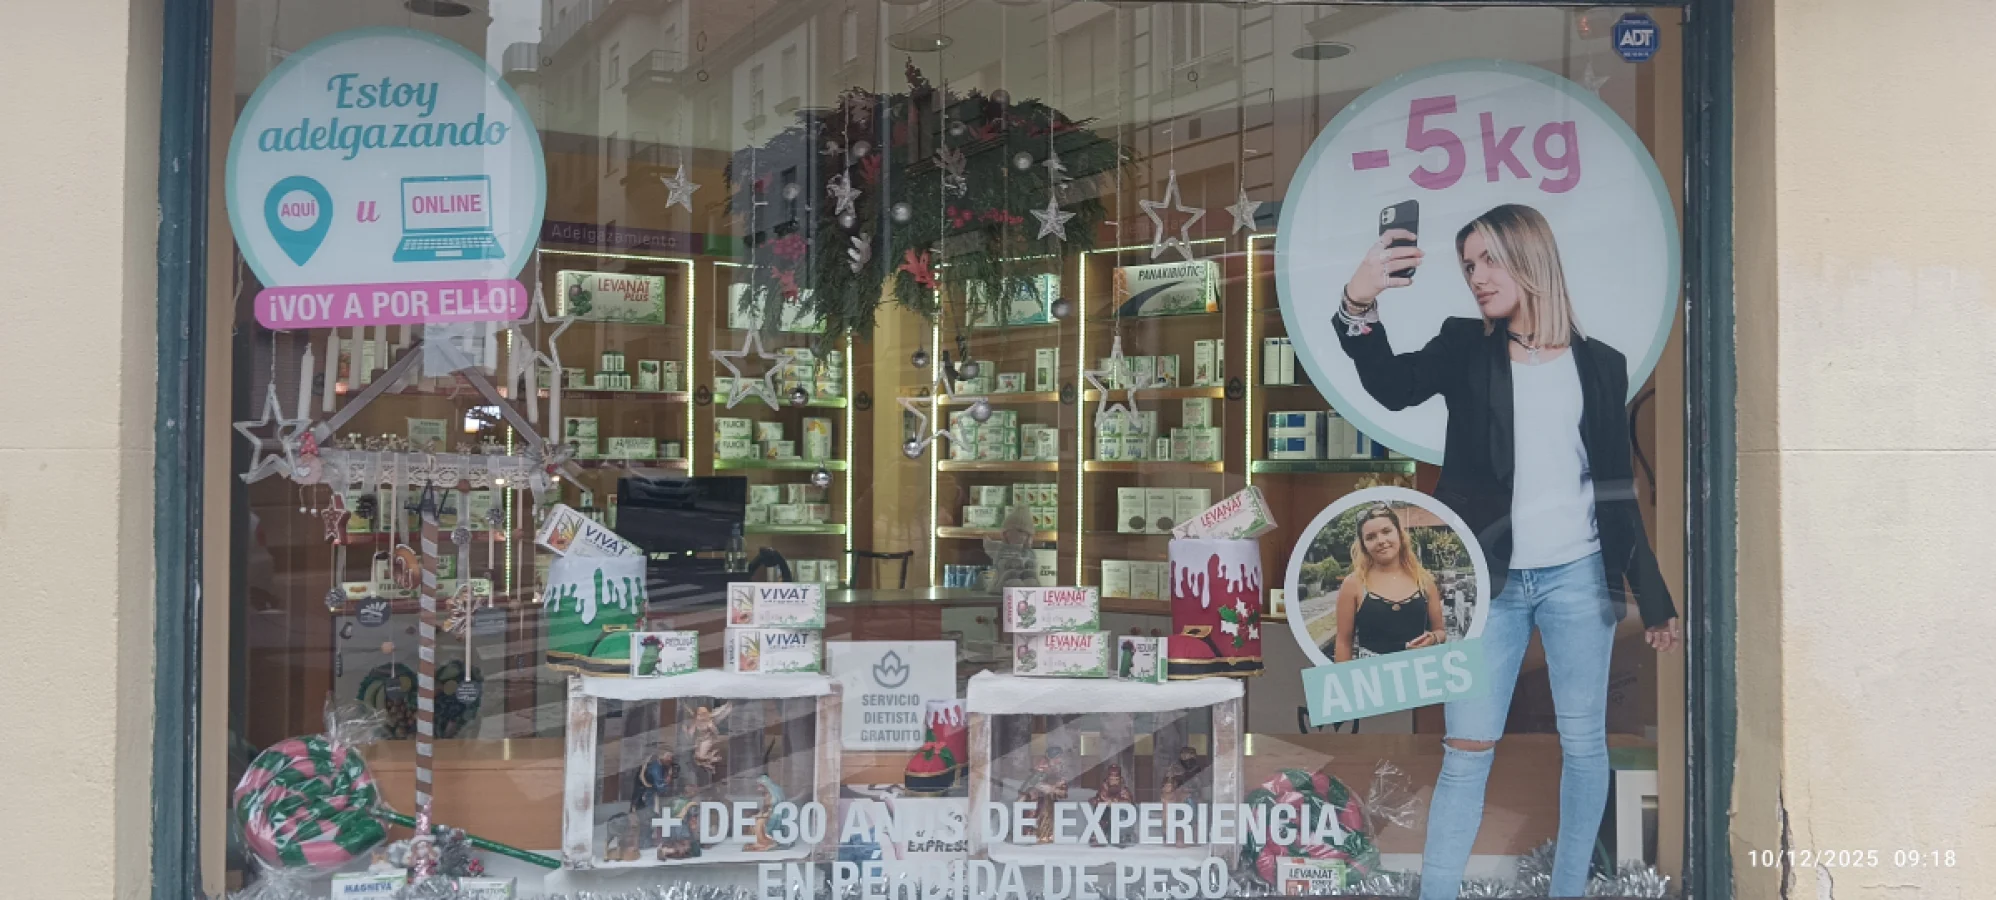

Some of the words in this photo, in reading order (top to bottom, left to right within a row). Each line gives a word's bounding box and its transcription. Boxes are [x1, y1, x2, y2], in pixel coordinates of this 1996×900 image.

[1620, 29, 1654, 46] ADT
[327, 73, 439, 118] Estoy
[258, 113, 511, 161] adelgazando
[280, 199, 316, 218] AQUÍ
[356, 200, 380, 223] u
[411, 193, 482, 214] ONLINE
[551, 223, 677, 248] Adelgazamiento
[597, 277, 650, 294] LEVANAT
[269, 293, 335, 323] ¡VOY
[343, 292, 364, 319] A
[372, 290, 429, 319] POR
[438, 286, 517, 316] ELLO!
[623, 291, 650, 302] PLUS
[1200, 493, 1242, 527] LEVANAT
[586, 524, 629, 557] VIVAT
[760, 588, 809, 600] VIVAT
[1043, 590, 1087, 603] LEVANAT
[765, 633, 809, 646] VIVAT
[1044, 635, 1094, 648] LEVANAT
[1321, 650, 1474, 718] ANTES
[861, 693, 920, 706] SERVICIO
[864, 711, 918, 725] DIETISTA
[861, 729, 921, 742] GRATUITO
[700, 801, 758, 844] DE
[772, 801, 827, 845] 30
[981, 801, 1038, 845] DE
[1053, 802, 1344, 846] EXPERIENCIA
[758, 861, 816, 900] EN
[1043, 859, 1099, 900] DE
[1115, 856, 1229, 900] PESO
[1288, 867, 1333, 879] LEVANAT
